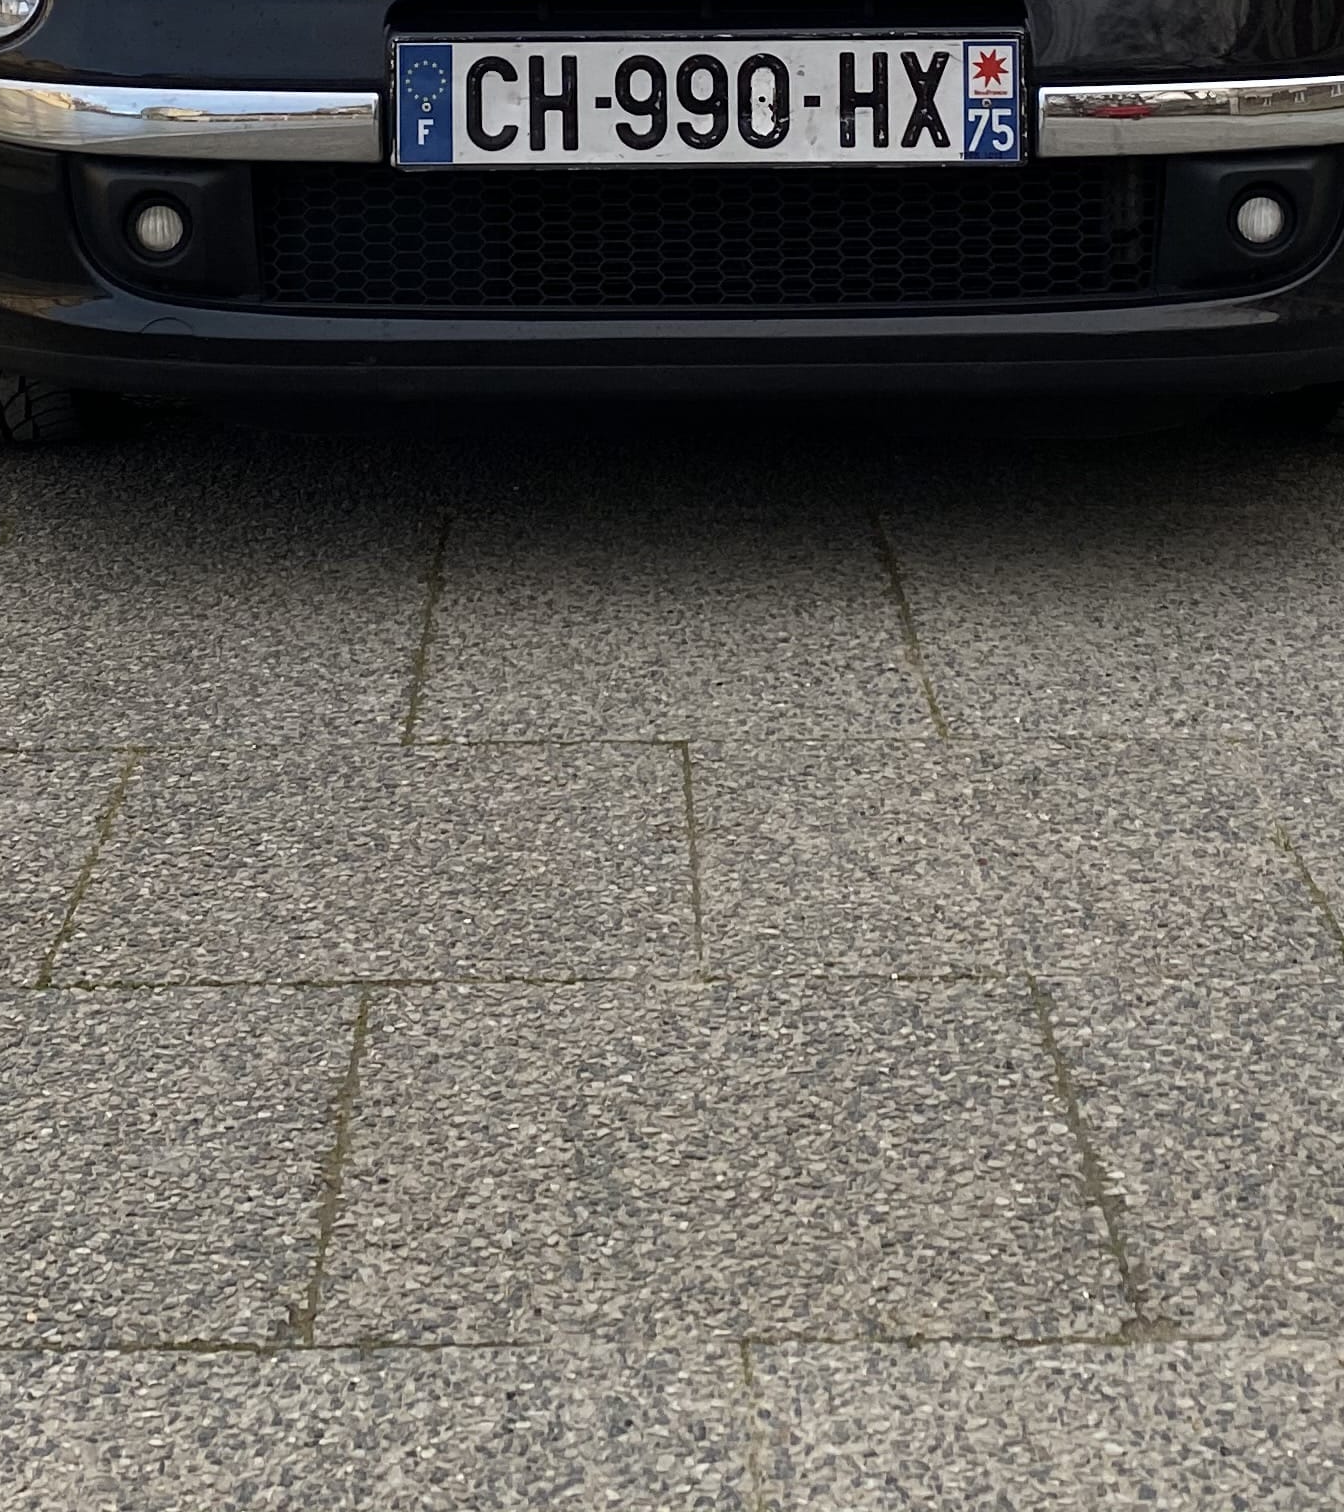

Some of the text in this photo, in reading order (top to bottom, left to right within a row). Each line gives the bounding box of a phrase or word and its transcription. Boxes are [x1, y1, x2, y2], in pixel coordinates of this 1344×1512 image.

[466, 51, 951, 151] CH-990-HX
[417, 119, 434, 145] F
[968, 108, 1014, 152] 75
